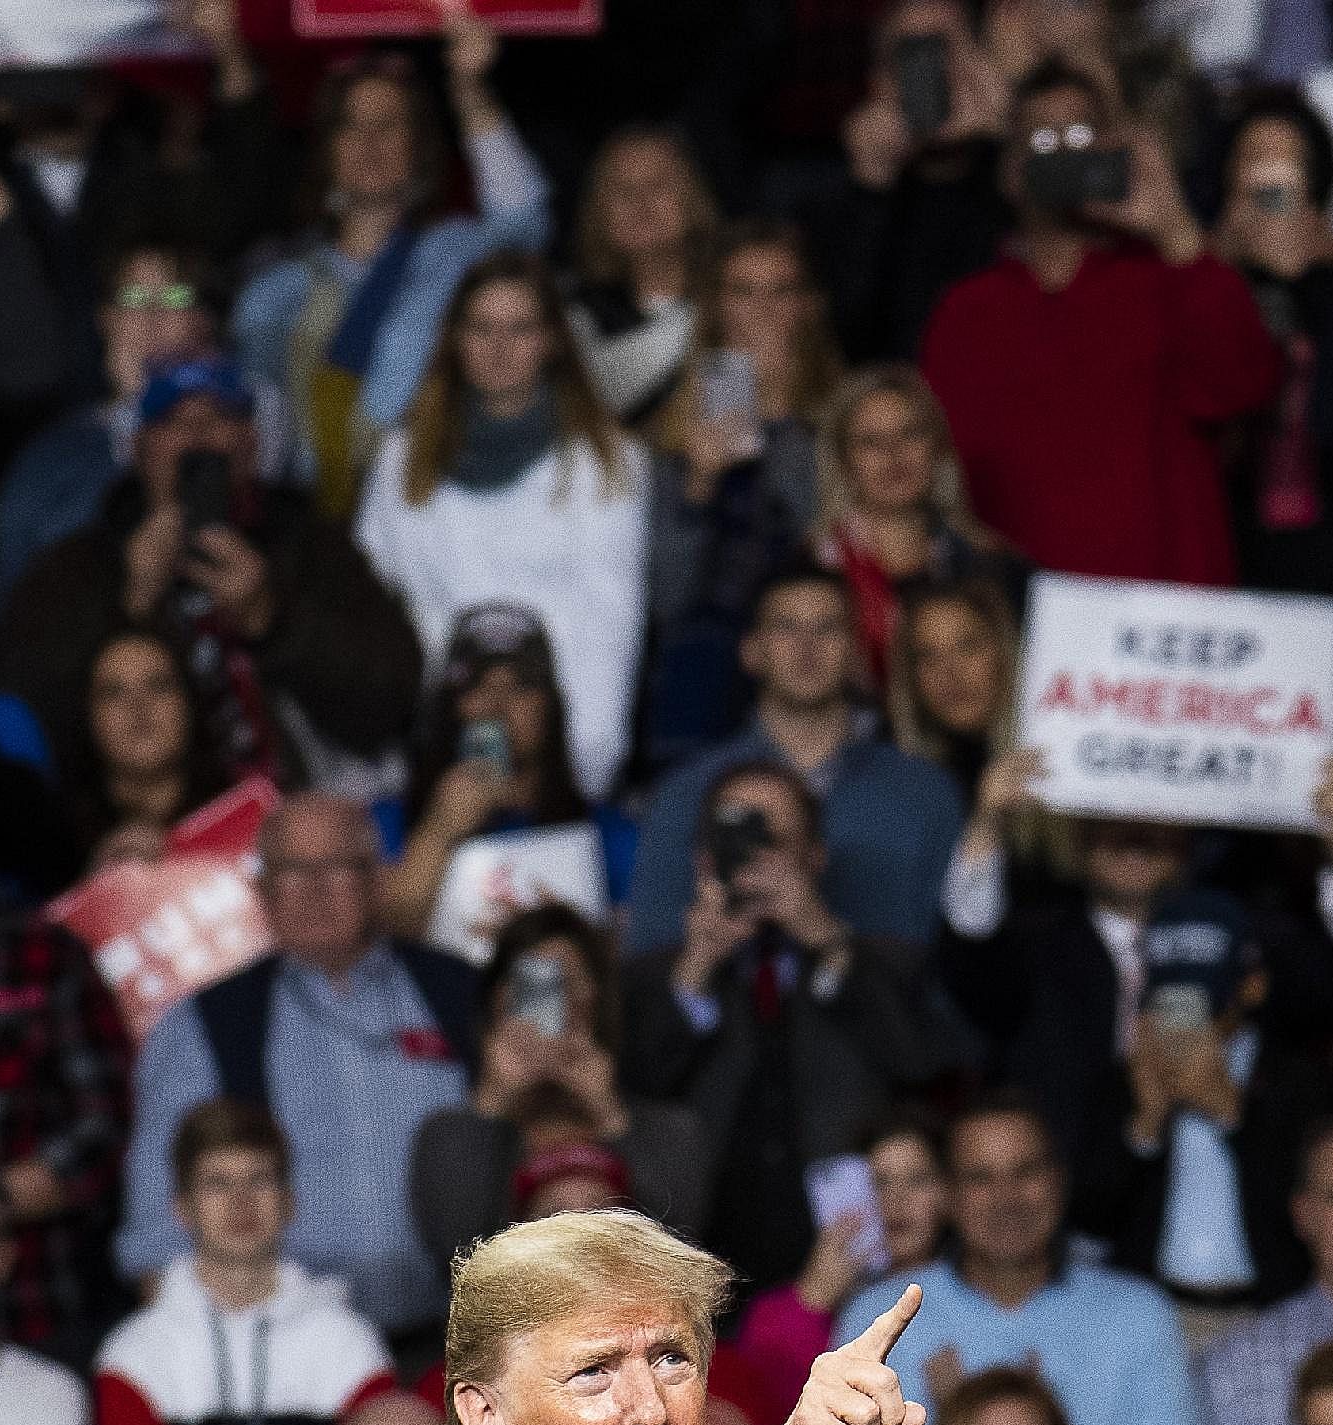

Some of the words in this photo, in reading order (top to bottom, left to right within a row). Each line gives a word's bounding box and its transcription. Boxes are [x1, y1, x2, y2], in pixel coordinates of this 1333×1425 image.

[1114, 622, 1262, 672] KEEP
[1034, 670, 1330, 738] AMERICA
[1075, 734, 1285, 788] GREAT!
